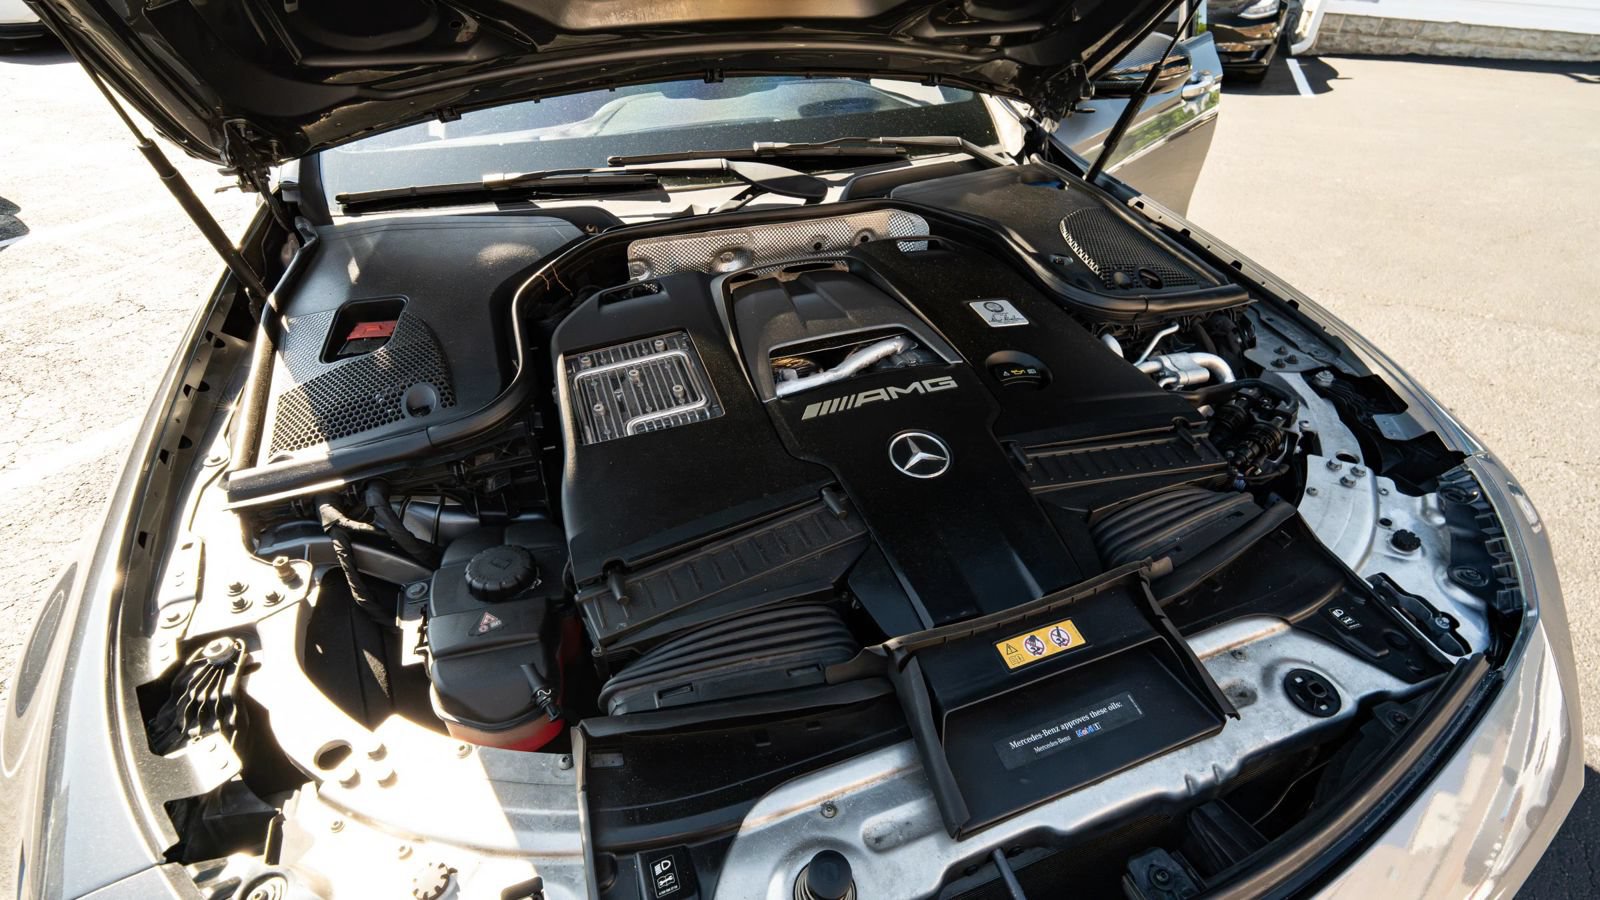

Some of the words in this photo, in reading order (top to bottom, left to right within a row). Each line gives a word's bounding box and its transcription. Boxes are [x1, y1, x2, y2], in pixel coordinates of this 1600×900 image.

[853, 376, 958, 408] AMG
[1009, 726, 1061, 749] Mercedes-Benz
[1060, 714, 1090, 731] approves
[1089, 707, 1108, 719] these
[1108, 701, 1123, 711] oils:
[1034, 735, 1071, 754] Mercedes-Benz
